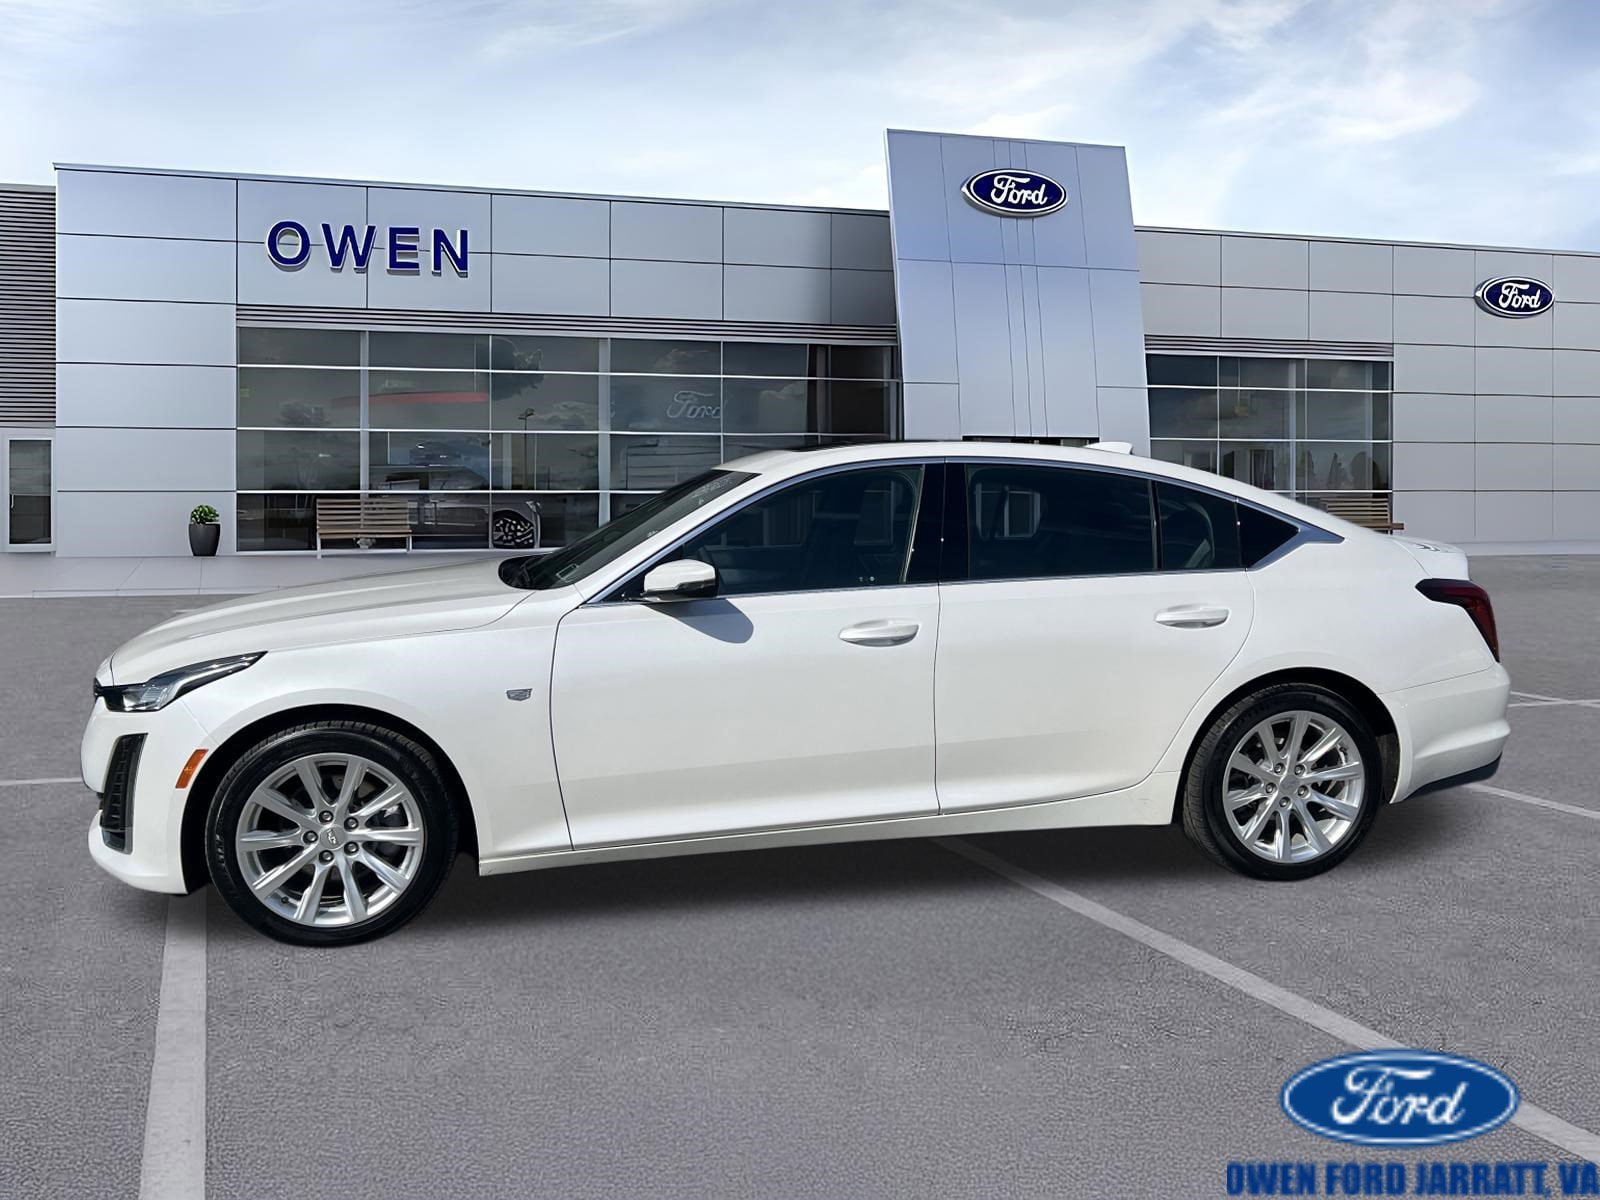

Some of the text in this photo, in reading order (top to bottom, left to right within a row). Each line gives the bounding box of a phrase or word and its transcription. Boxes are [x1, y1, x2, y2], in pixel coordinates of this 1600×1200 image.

[990, 174, 1048, 205] Ford
[266, 220, 469, 277] OWEN
[1498, 282, 1542, 309] Ford
